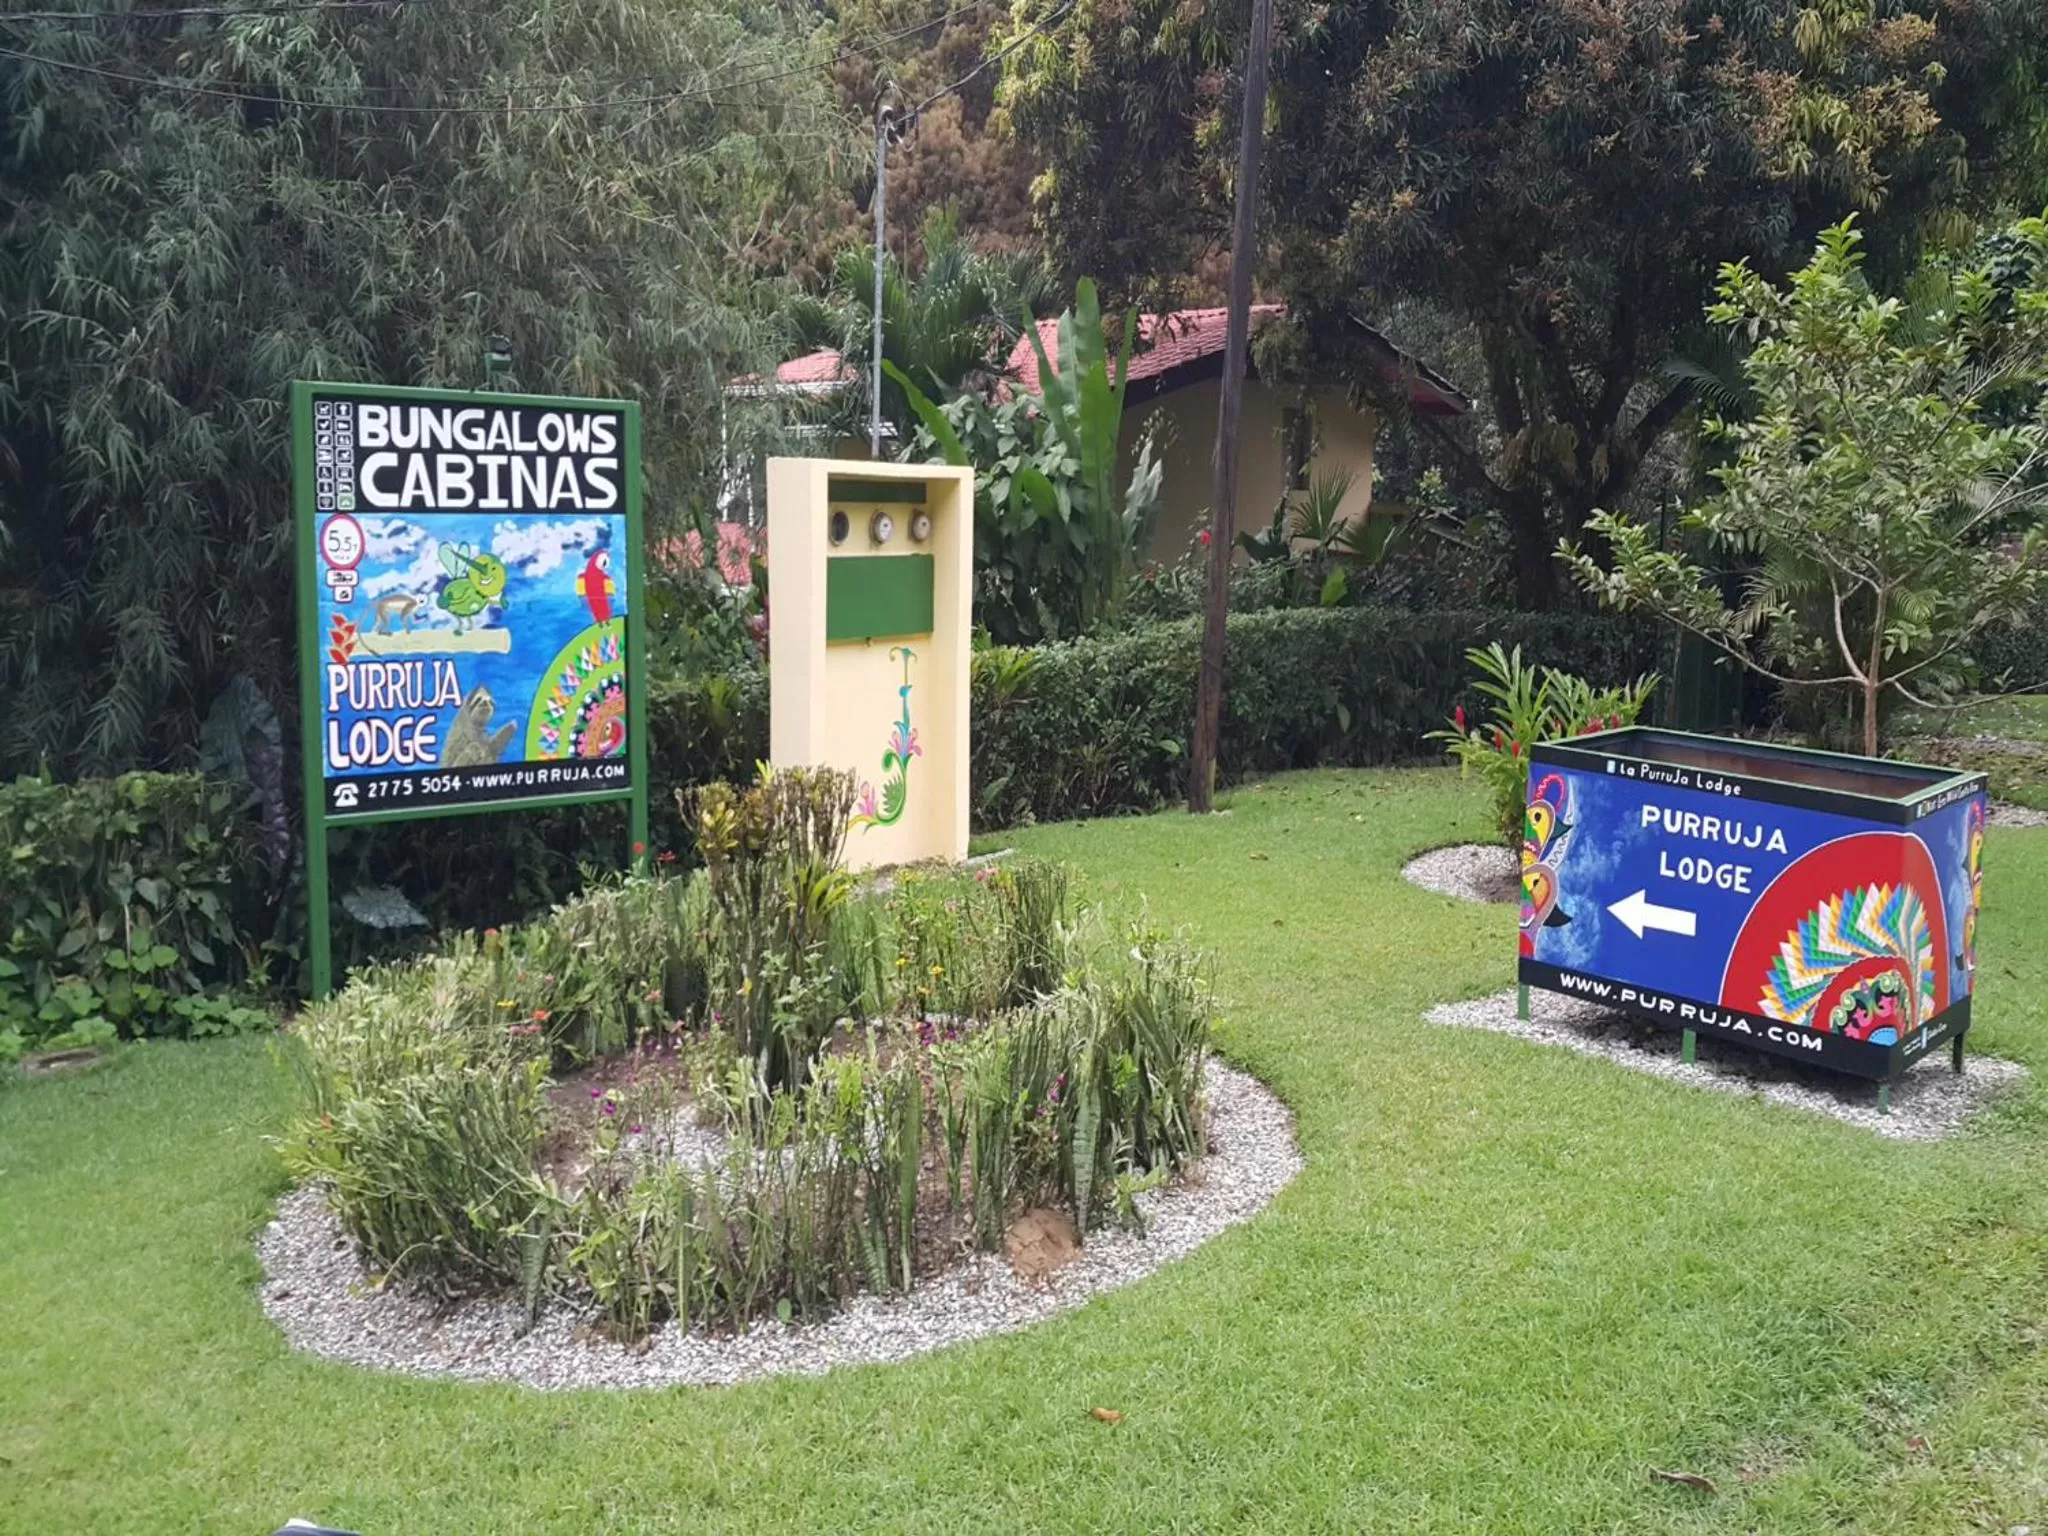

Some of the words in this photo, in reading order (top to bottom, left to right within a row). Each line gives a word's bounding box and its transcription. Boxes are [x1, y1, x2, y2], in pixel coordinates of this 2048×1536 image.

[358, 404, 617, 454] BUNGALOWS
[360, 452, 618, 509] CABINAS
[327, 659, 462, 712] PURRUJA
[329, 715, 438, 769] LODGE
[368, 779, 413, 798] 2775
[421, 775, 462, 794] 5054
[1620, 762, 1635, 777] La
[1696, 773, 1741, 796] Lodge
[1641, 804, 1788, 854] PURRUJA
[1660, 851, 1752, 894] LODGE
